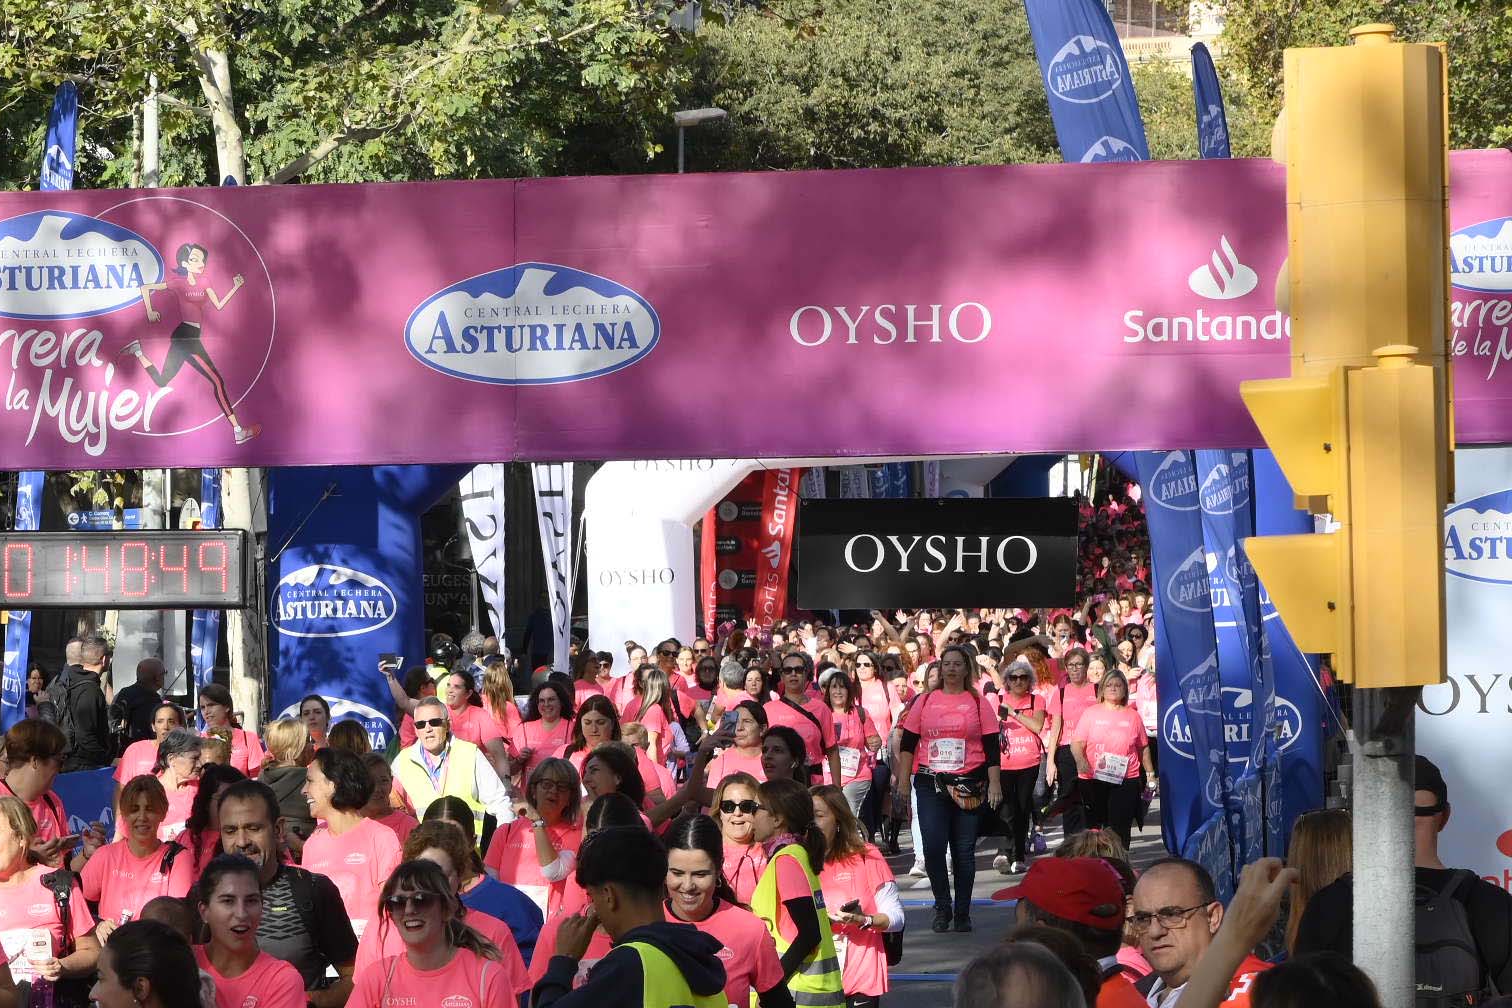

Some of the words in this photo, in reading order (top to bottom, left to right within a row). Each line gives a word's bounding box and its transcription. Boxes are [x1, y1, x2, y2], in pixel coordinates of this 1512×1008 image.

[66, 246, 139, 257] LECHERA
[465, 304, 544, 319] CENTRAL
[551, 303, 632, 316] LECHERA
[424, 309, 640, 354] ASTURIANA
[790, 302, 992, 347] OYSHO
[5, 378, 29, 411] la
[26, 361, 174, 456] Mujer
[844, 532, 1039, 575] OYSHO
[599, 567, 675, 586] OYSHO
[287, 589, 326, 598] CENTRAL
[330, 588, 384, 598] LECHERA
[274, 597, 388, 621] ASTURIANA
